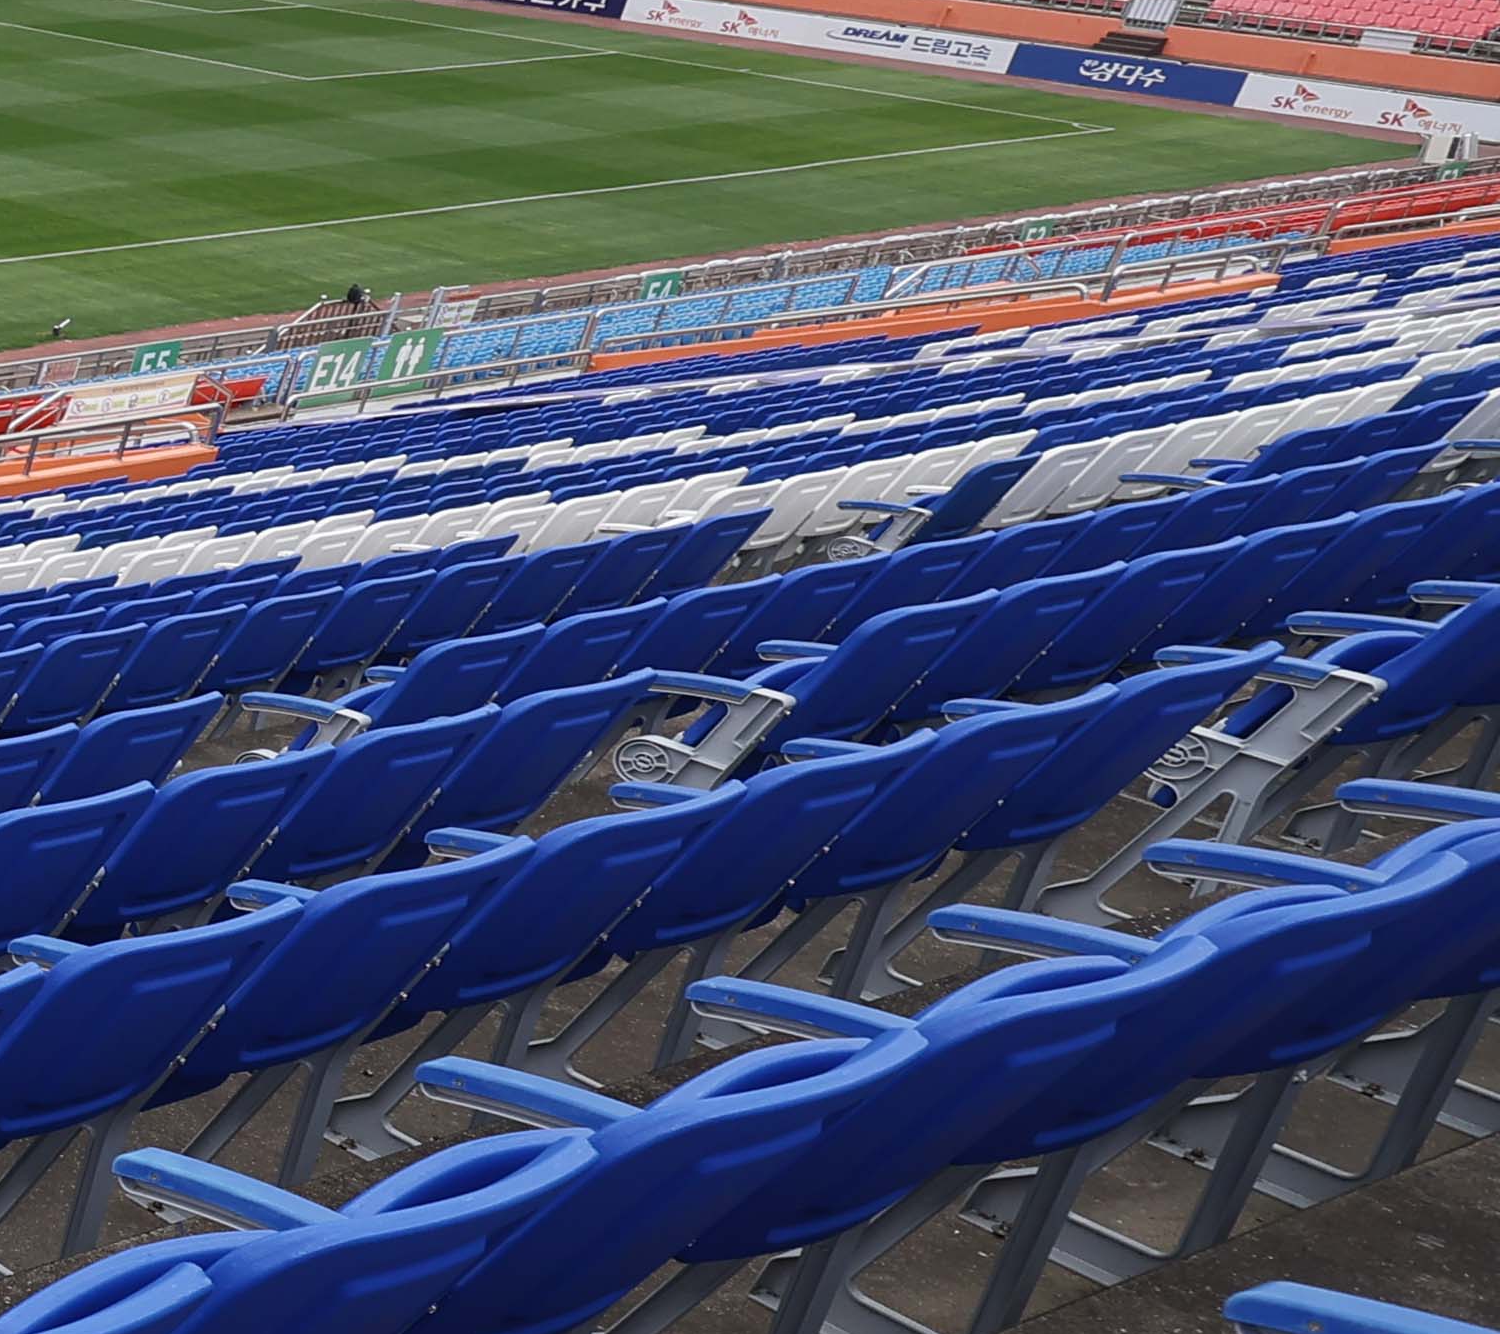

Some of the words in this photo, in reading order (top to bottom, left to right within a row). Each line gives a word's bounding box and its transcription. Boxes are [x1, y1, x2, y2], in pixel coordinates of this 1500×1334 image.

[647, 10, 664, 22] SK
[720, 20, 740, 34] SK
[843, 26, 908, 44] DREAM
[911, 35, 992, 61] 드림고속
[1271, 96, 1298, 110] SK
[1303, 104, 1353, 119] energy
[1377, 112, 1406, 127] SK
[1418, 118, 1462, 134] 에너지
[309, 351, 361, 393] E14
